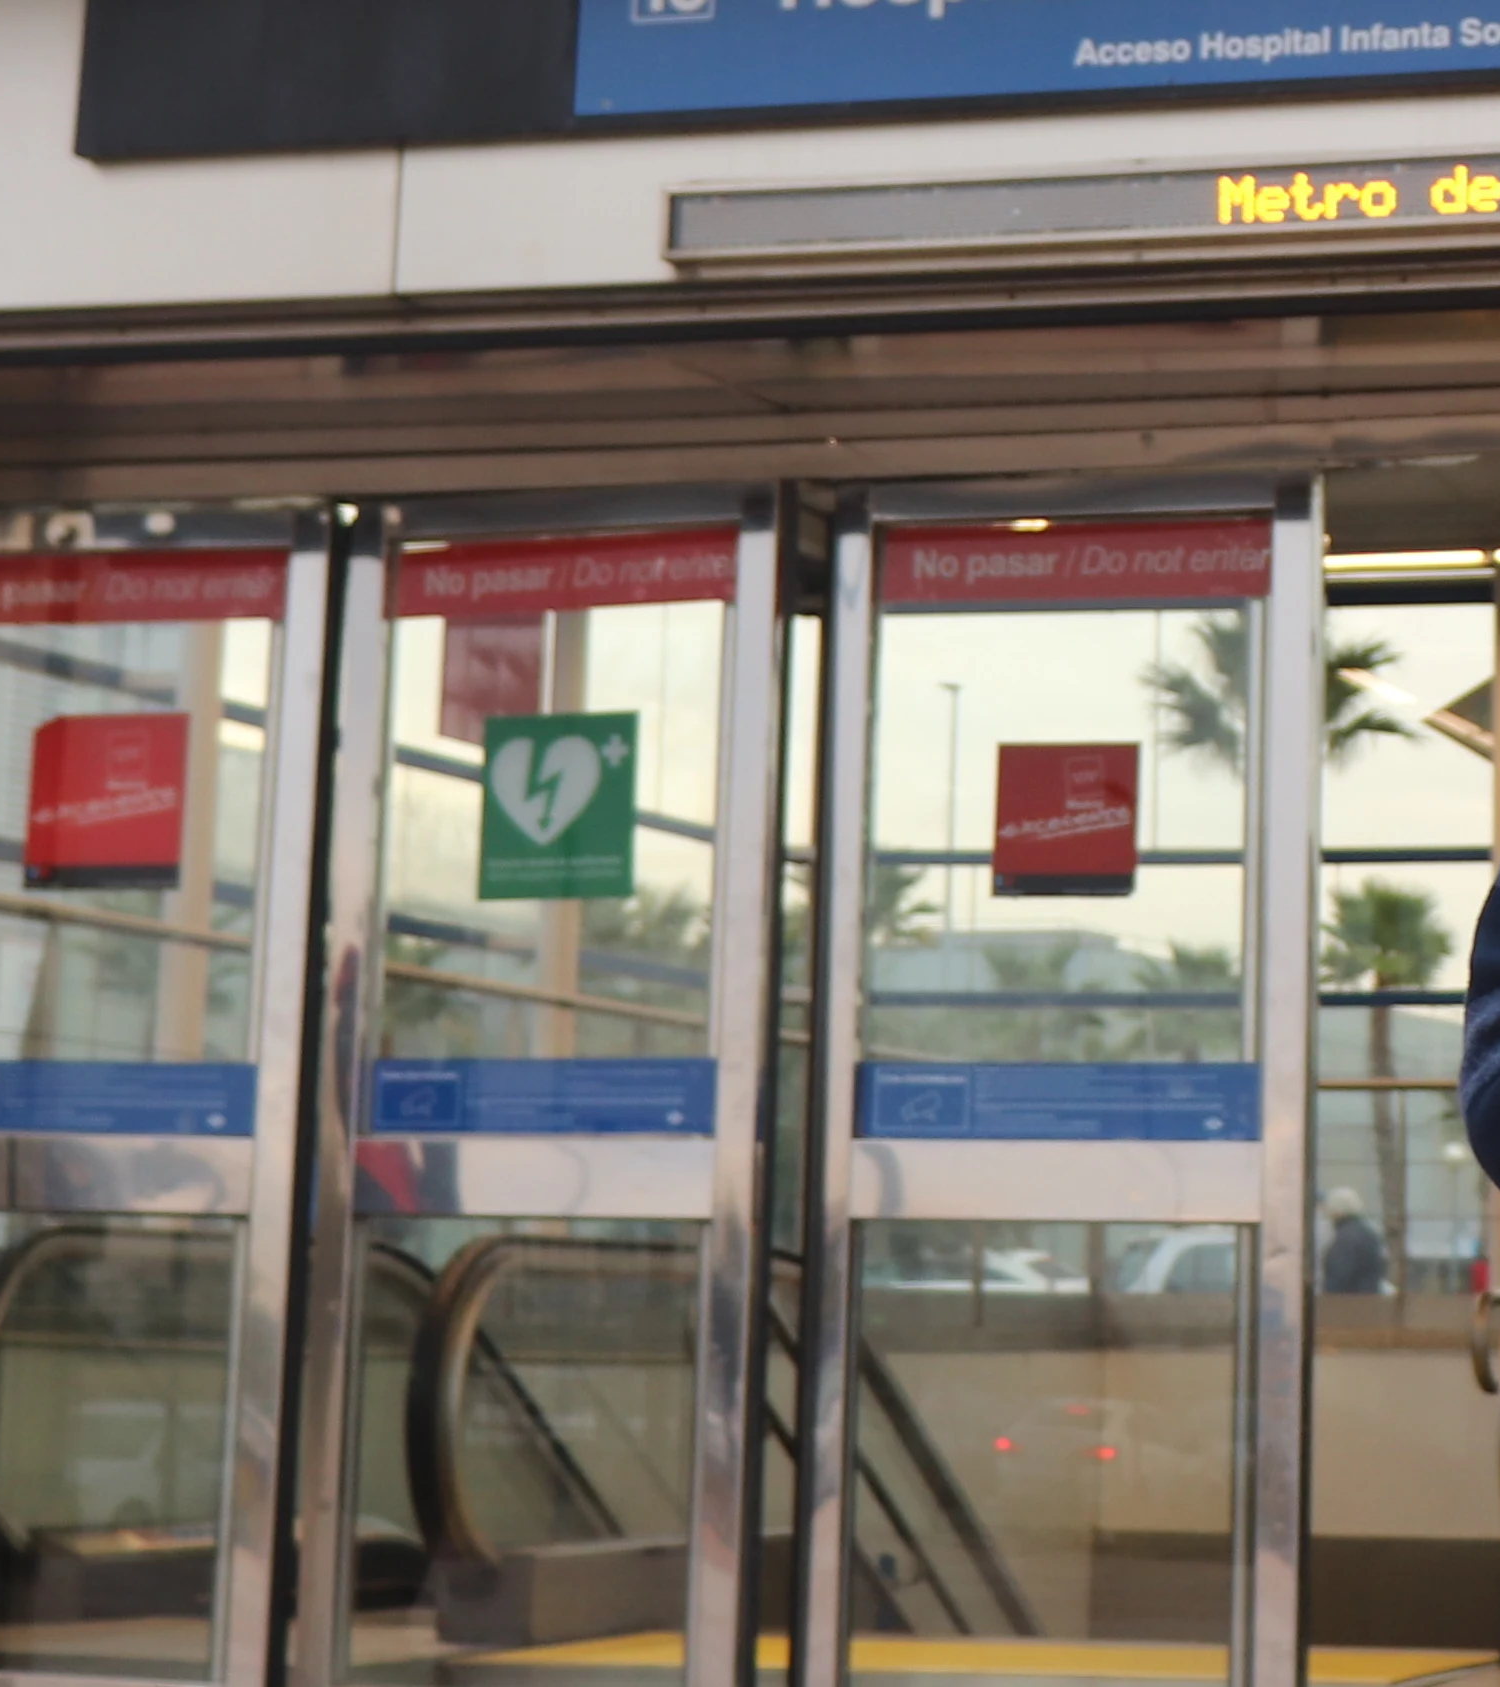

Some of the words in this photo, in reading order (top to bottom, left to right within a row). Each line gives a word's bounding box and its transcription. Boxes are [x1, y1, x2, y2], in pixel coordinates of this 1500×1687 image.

[1074, 38, 1191, 67] Acceso
[1200, 26, 1331, 63] Hospital
[1340, 17, 1451, 52] Infanta
[1217, 171, 1397, 225] Metro
[424, 567, 467, 596] No
[470, 565, 553, 601] pasar
[570, 556, 614, 588] Do
[668, 553, 736, 581] ente
[912, 548, 960, 580] No
[965, 550, 1061, 584] pasar
[1079, 544, 1128, 576] Do
[1132, 543, 1186, 573] not
